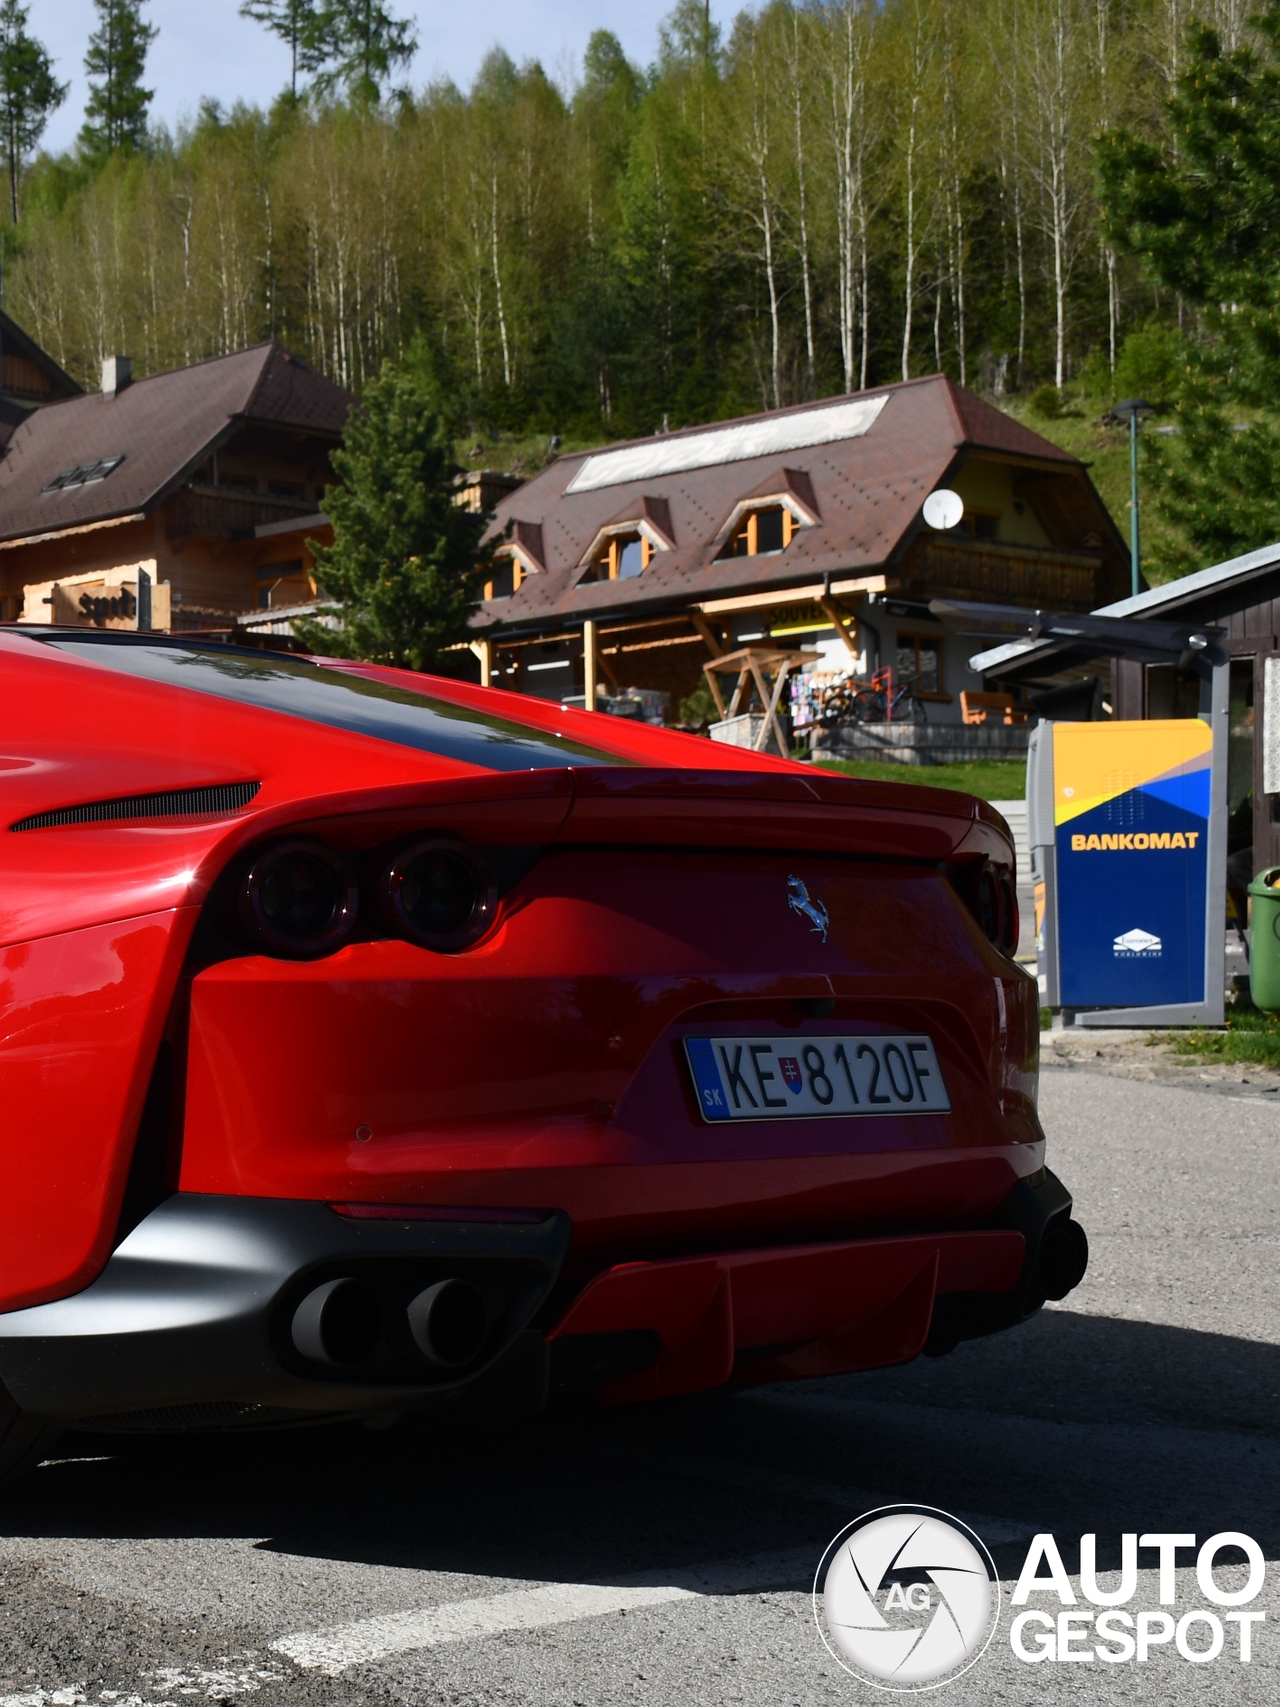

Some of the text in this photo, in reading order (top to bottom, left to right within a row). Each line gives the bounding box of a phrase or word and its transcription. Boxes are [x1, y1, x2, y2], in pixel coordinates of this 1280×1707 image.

[1071, 832, 1199, 851] BANKOMAT
[720, 1044, 787, 1109] KE
[703, 1088, 723, 1106] SK
